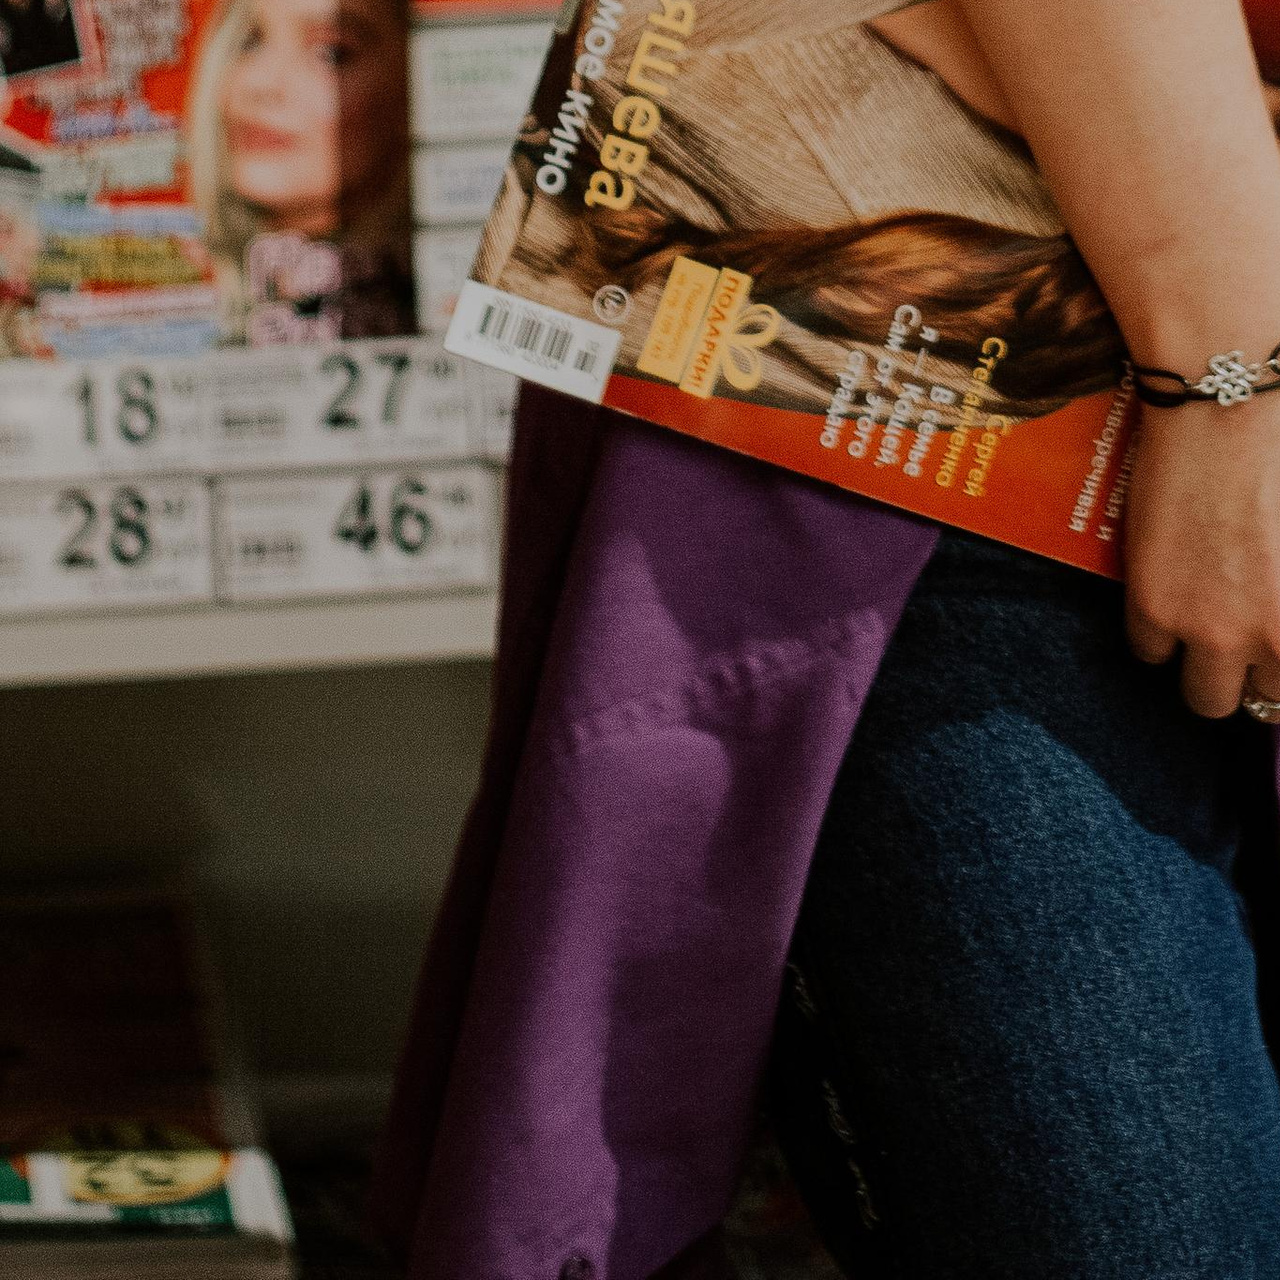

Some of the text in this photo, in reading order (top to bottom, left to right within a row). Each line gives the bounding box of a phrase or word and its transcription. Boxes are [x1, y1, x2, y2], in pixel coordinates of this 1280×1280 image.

[534, 90, 592, 193] кино
[918, 325, 940, 343] я
[73, 368, 159, 446] 18
[320, 353, 412, 431] 27
[815, 348, 865, 448] страдаю
[847, 303, 922, 458] Сам от этого
[903, 385, 956, 477] В семье
[960, 412, 1010, 498] Сергей
[57, 484, 152, 570] 28
[335, 476, 434, 554] 46
